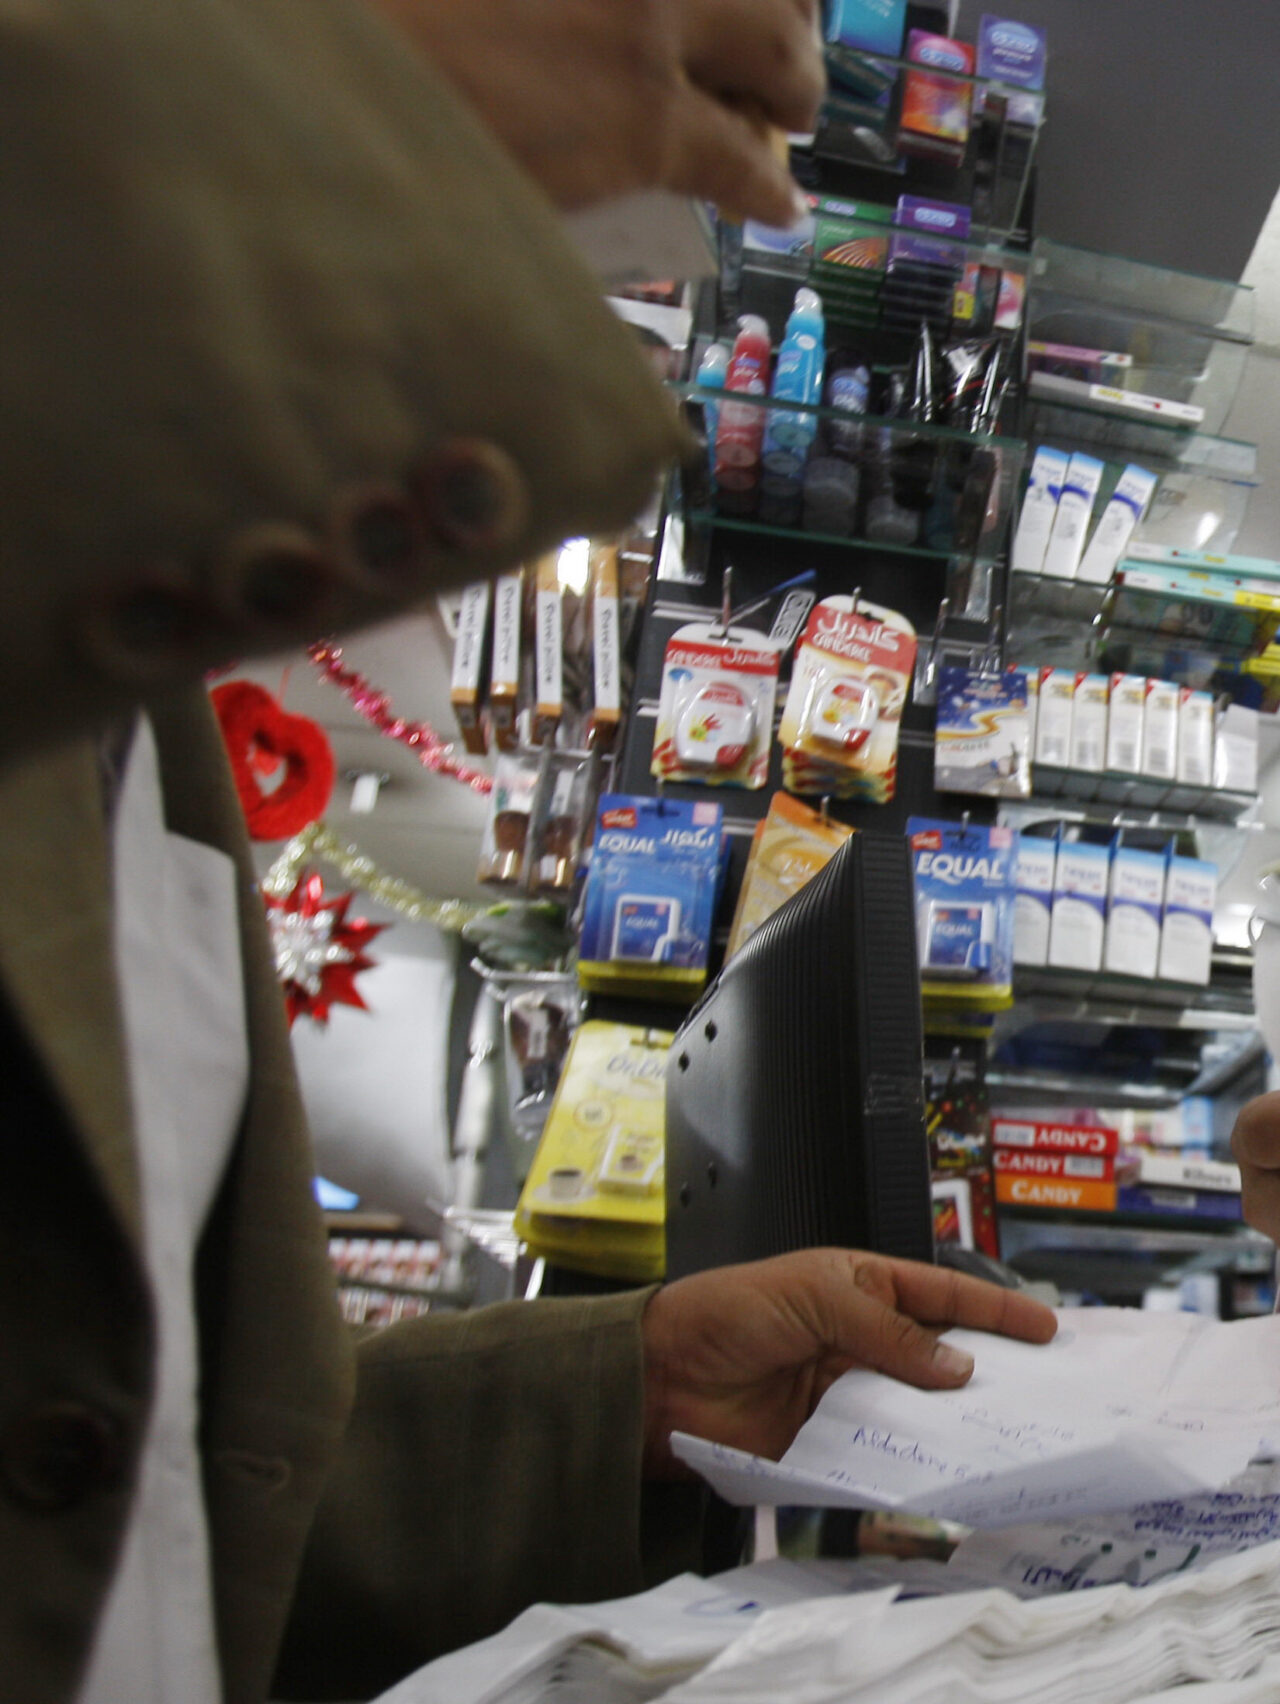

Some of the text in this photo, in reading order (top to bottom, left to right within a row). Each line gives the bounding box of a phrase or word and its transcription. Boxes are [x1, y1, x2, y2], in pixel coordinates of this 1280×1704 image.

[599, 833, 656, 855] EQUAL
[916, 851, 1005, 886] EQUAL
[624, 917, 658, 930] EQUAL
[935, 920, 973, 936] EQUAL
[1037, 1129, 1107, 1152] CANDY
[992, 1150, 1061, 1175] CANDY
[1011, 1180, 1083, 1204] CANDY
